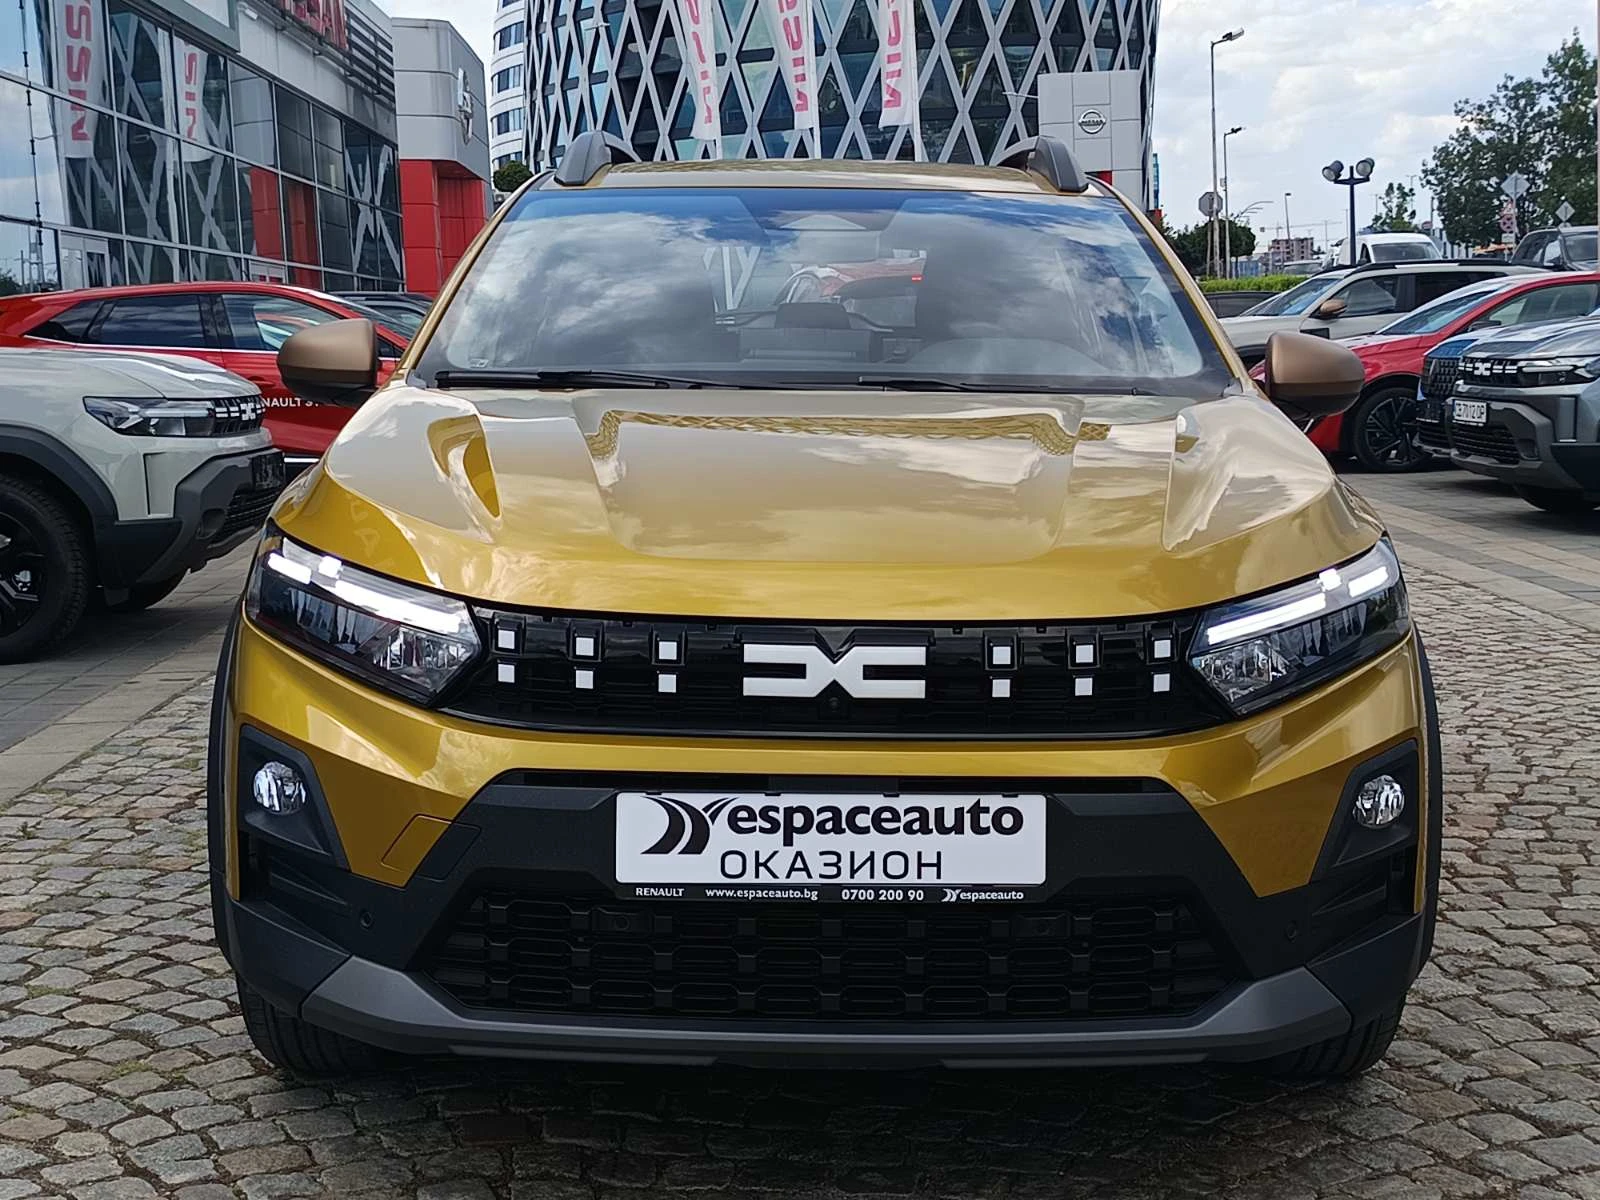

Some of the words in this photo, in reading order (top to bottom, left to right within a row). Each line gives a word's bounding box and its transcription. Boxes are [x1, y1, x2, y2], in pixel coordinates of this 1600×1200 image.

[66, 0, 91, 141] NISS
[727, 798, 1024, 847] espaceauto
[720, 849, 942, 880] ОКАЗИОН
[635, 887, 685, 897] RENAULT
[705, 888, 818, 901] www.espaceauto.bg
[841, 889, 875, 901] 0700
[878, 889, 904, 901] 200
[907, 890, 925, 901] 90
[959, 889, 1024, 902] espaceauto
